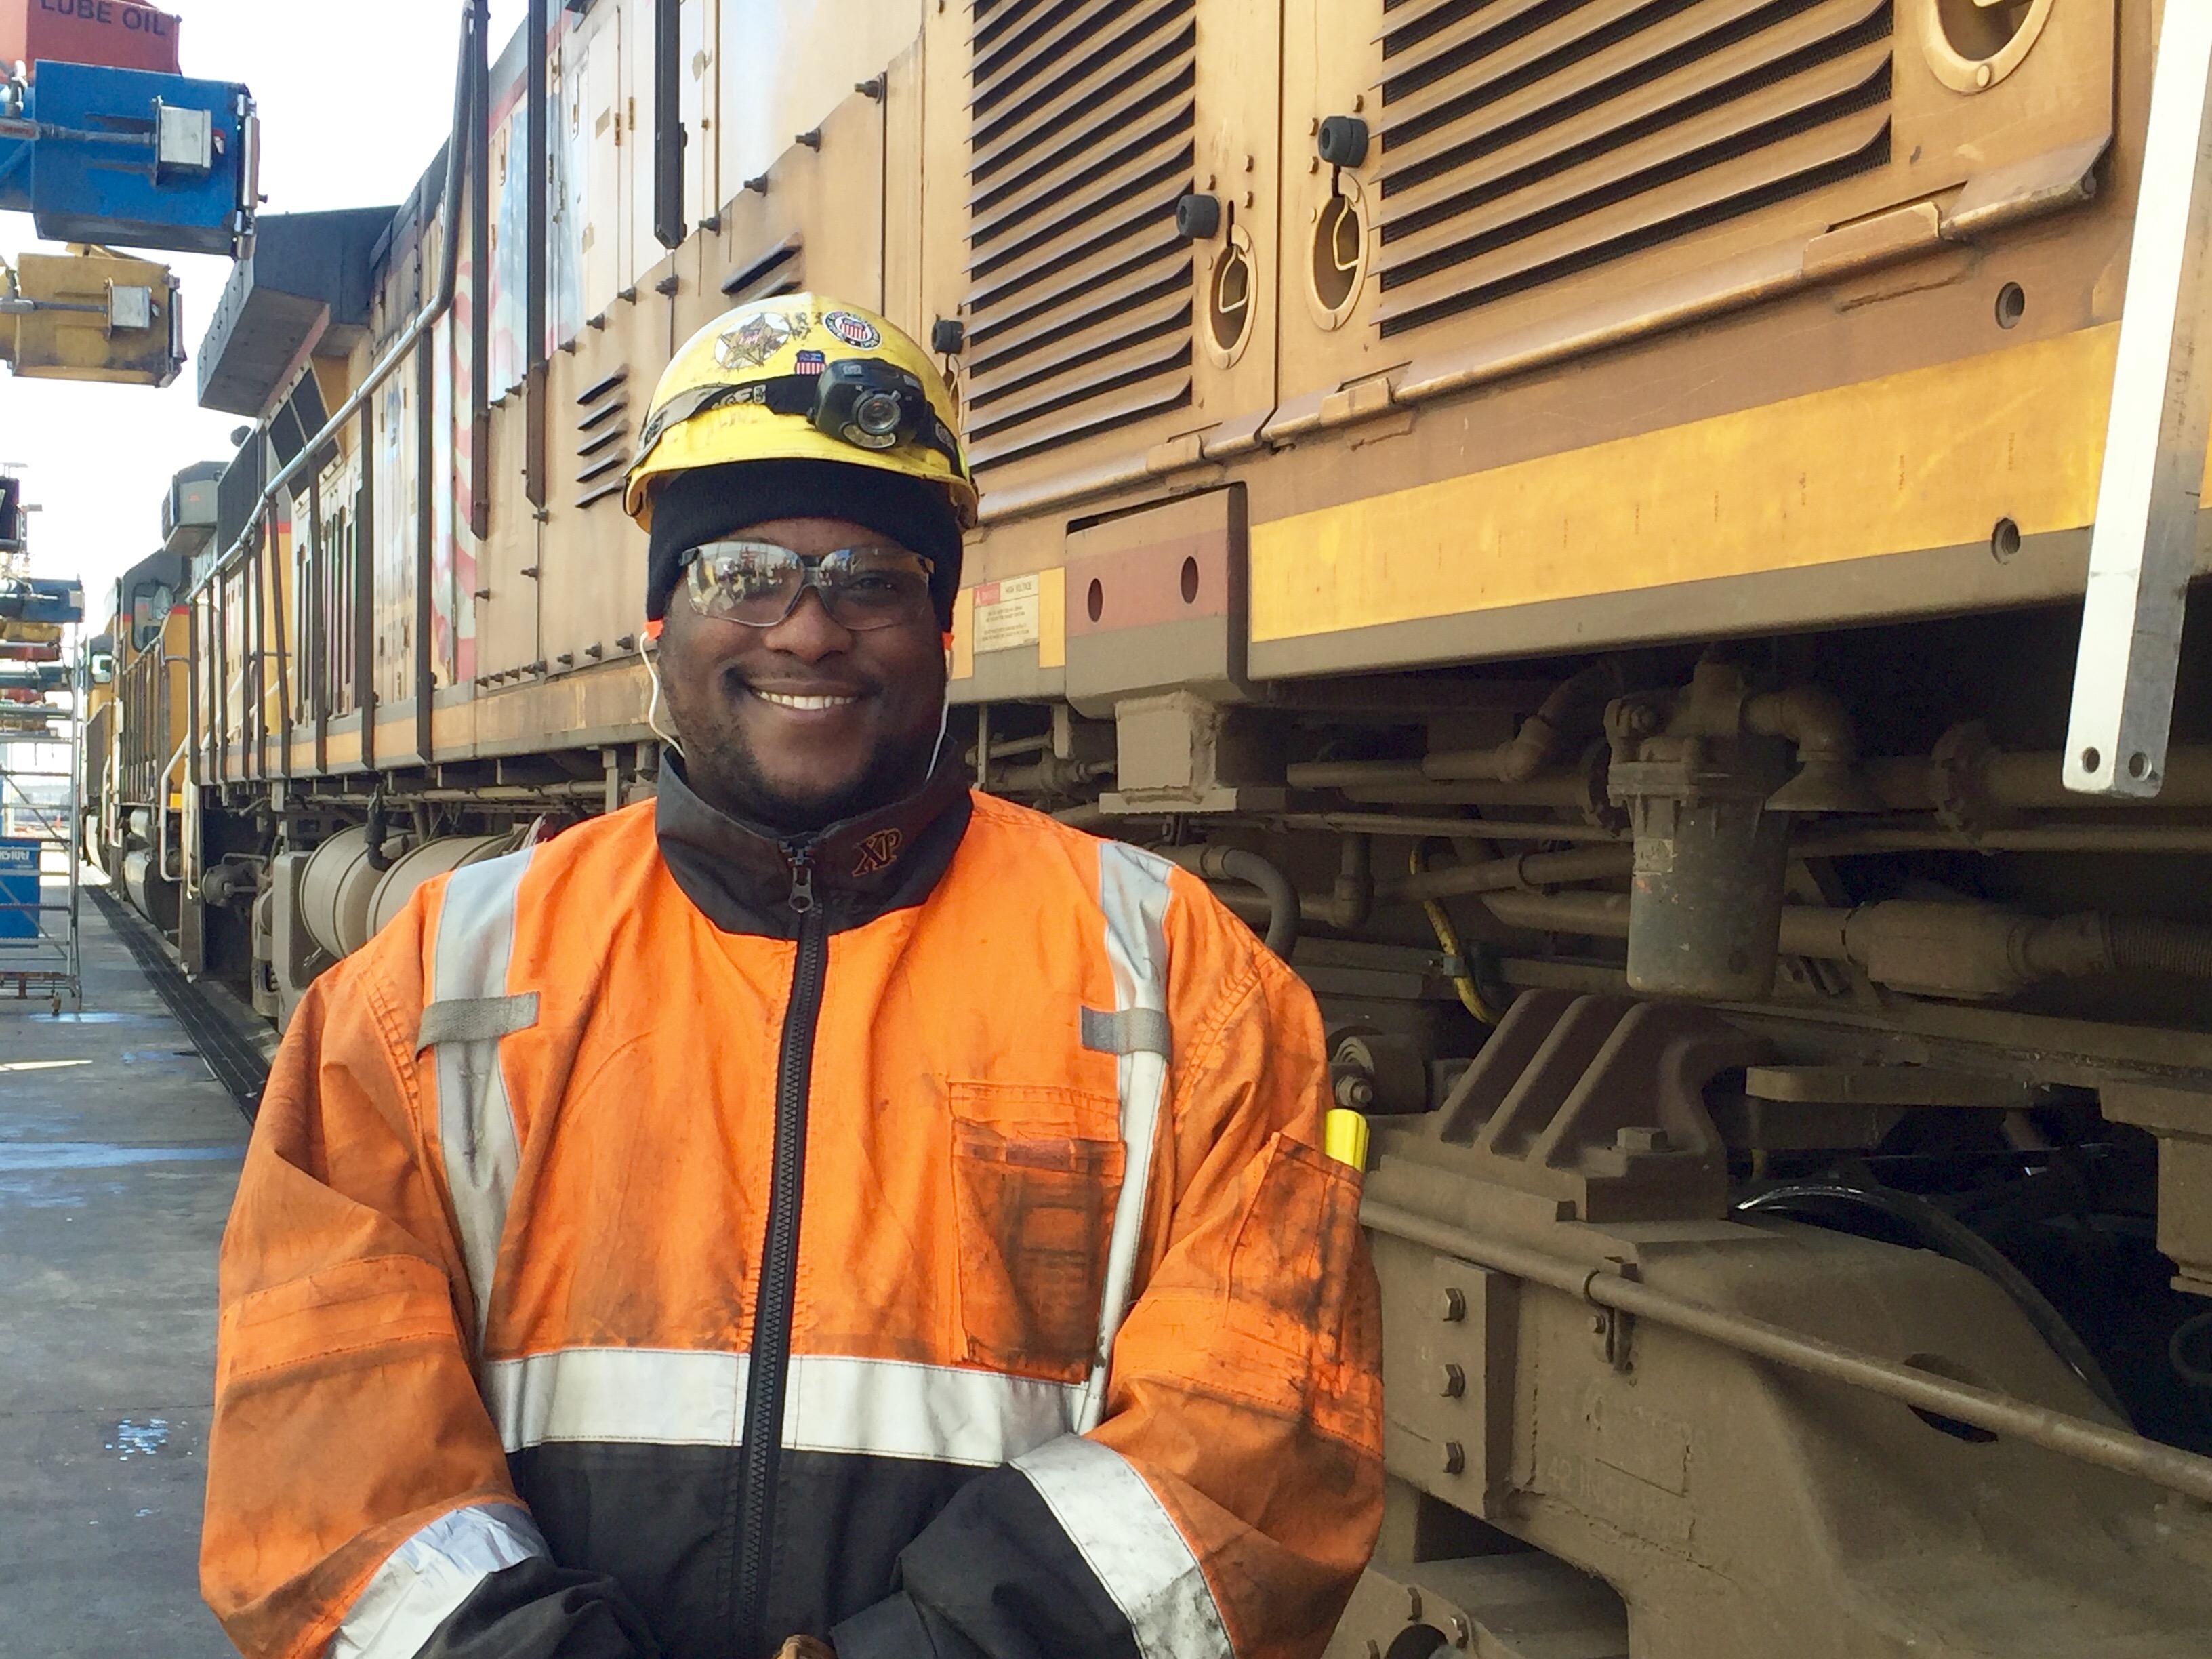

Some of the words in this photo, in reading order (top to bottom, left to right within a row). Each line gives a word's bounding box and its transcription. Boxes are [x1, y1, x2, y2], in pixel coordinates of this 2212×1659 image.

[41, 0, 112, 24] LUBE
[122, 9, 165, 35] OIL
[852, 828, 902, 877] XP
